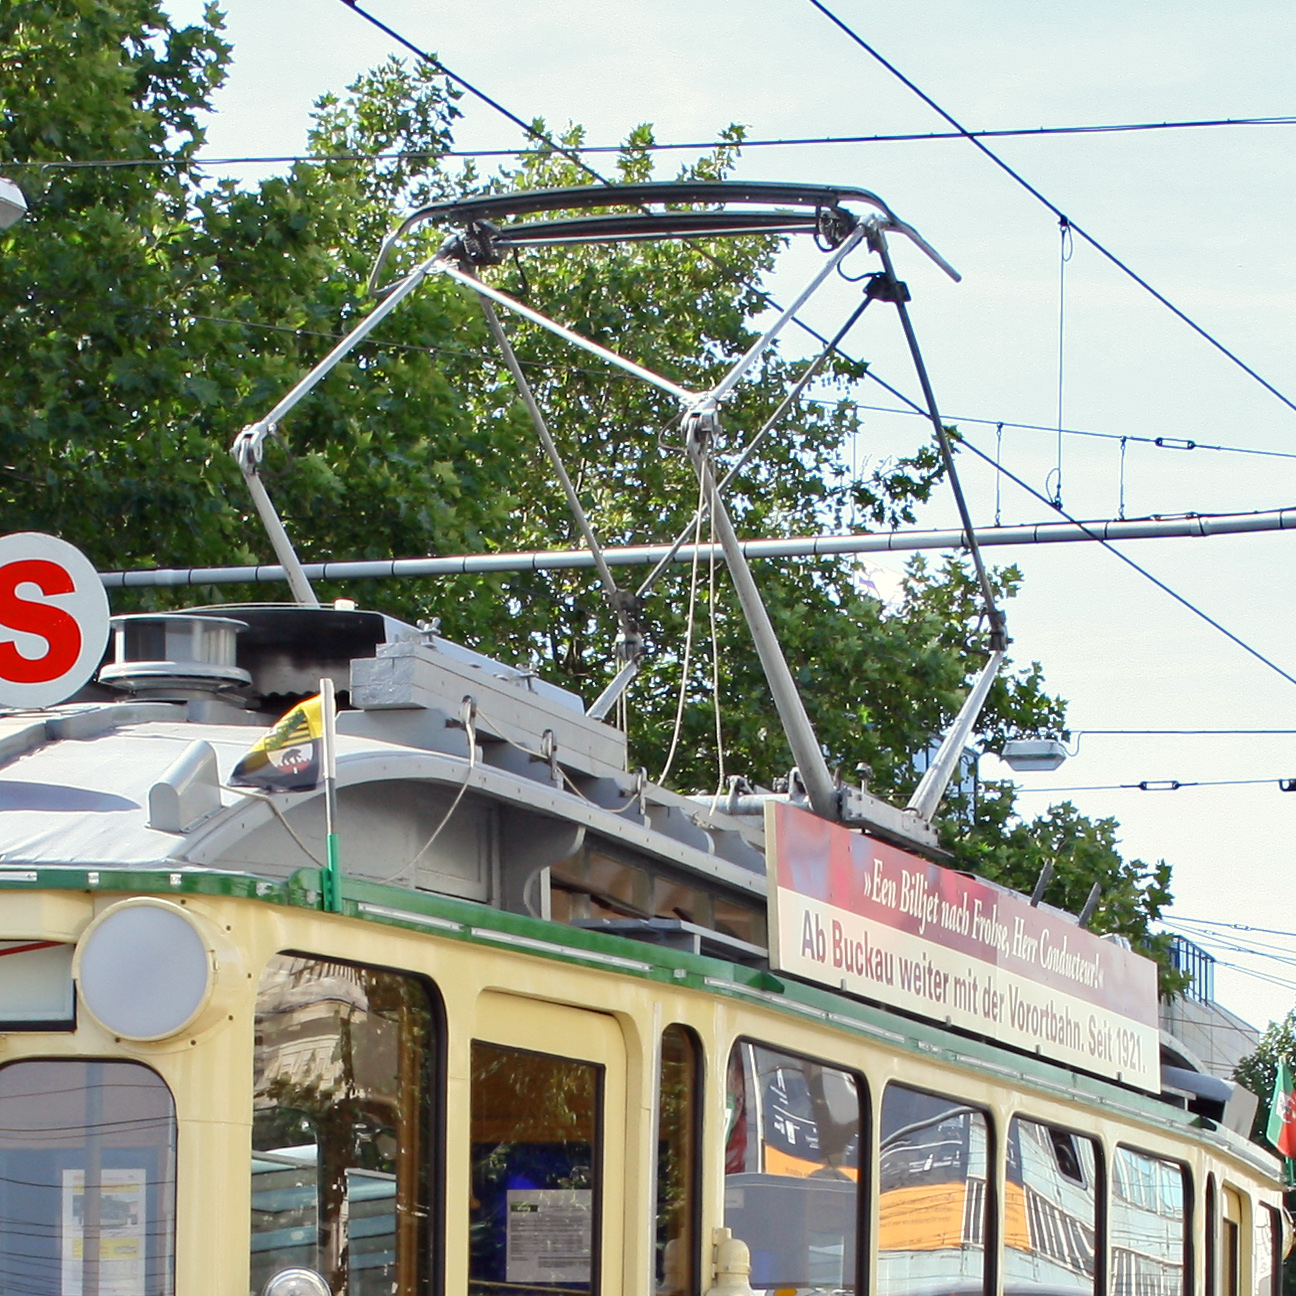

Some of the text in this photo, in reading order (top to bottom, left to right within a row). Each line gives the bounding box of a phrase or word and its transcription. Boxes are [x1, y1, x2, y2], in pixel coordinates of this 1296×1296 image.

[899, 869, 940, 935] Billjet
[940, 891, 971, 937] nach
[1012, 915, 1038, 964] Herr
[801, 909, 1146, 1074] Ab Buckau weiter mit der Vorortbahn. Seit 1921.
